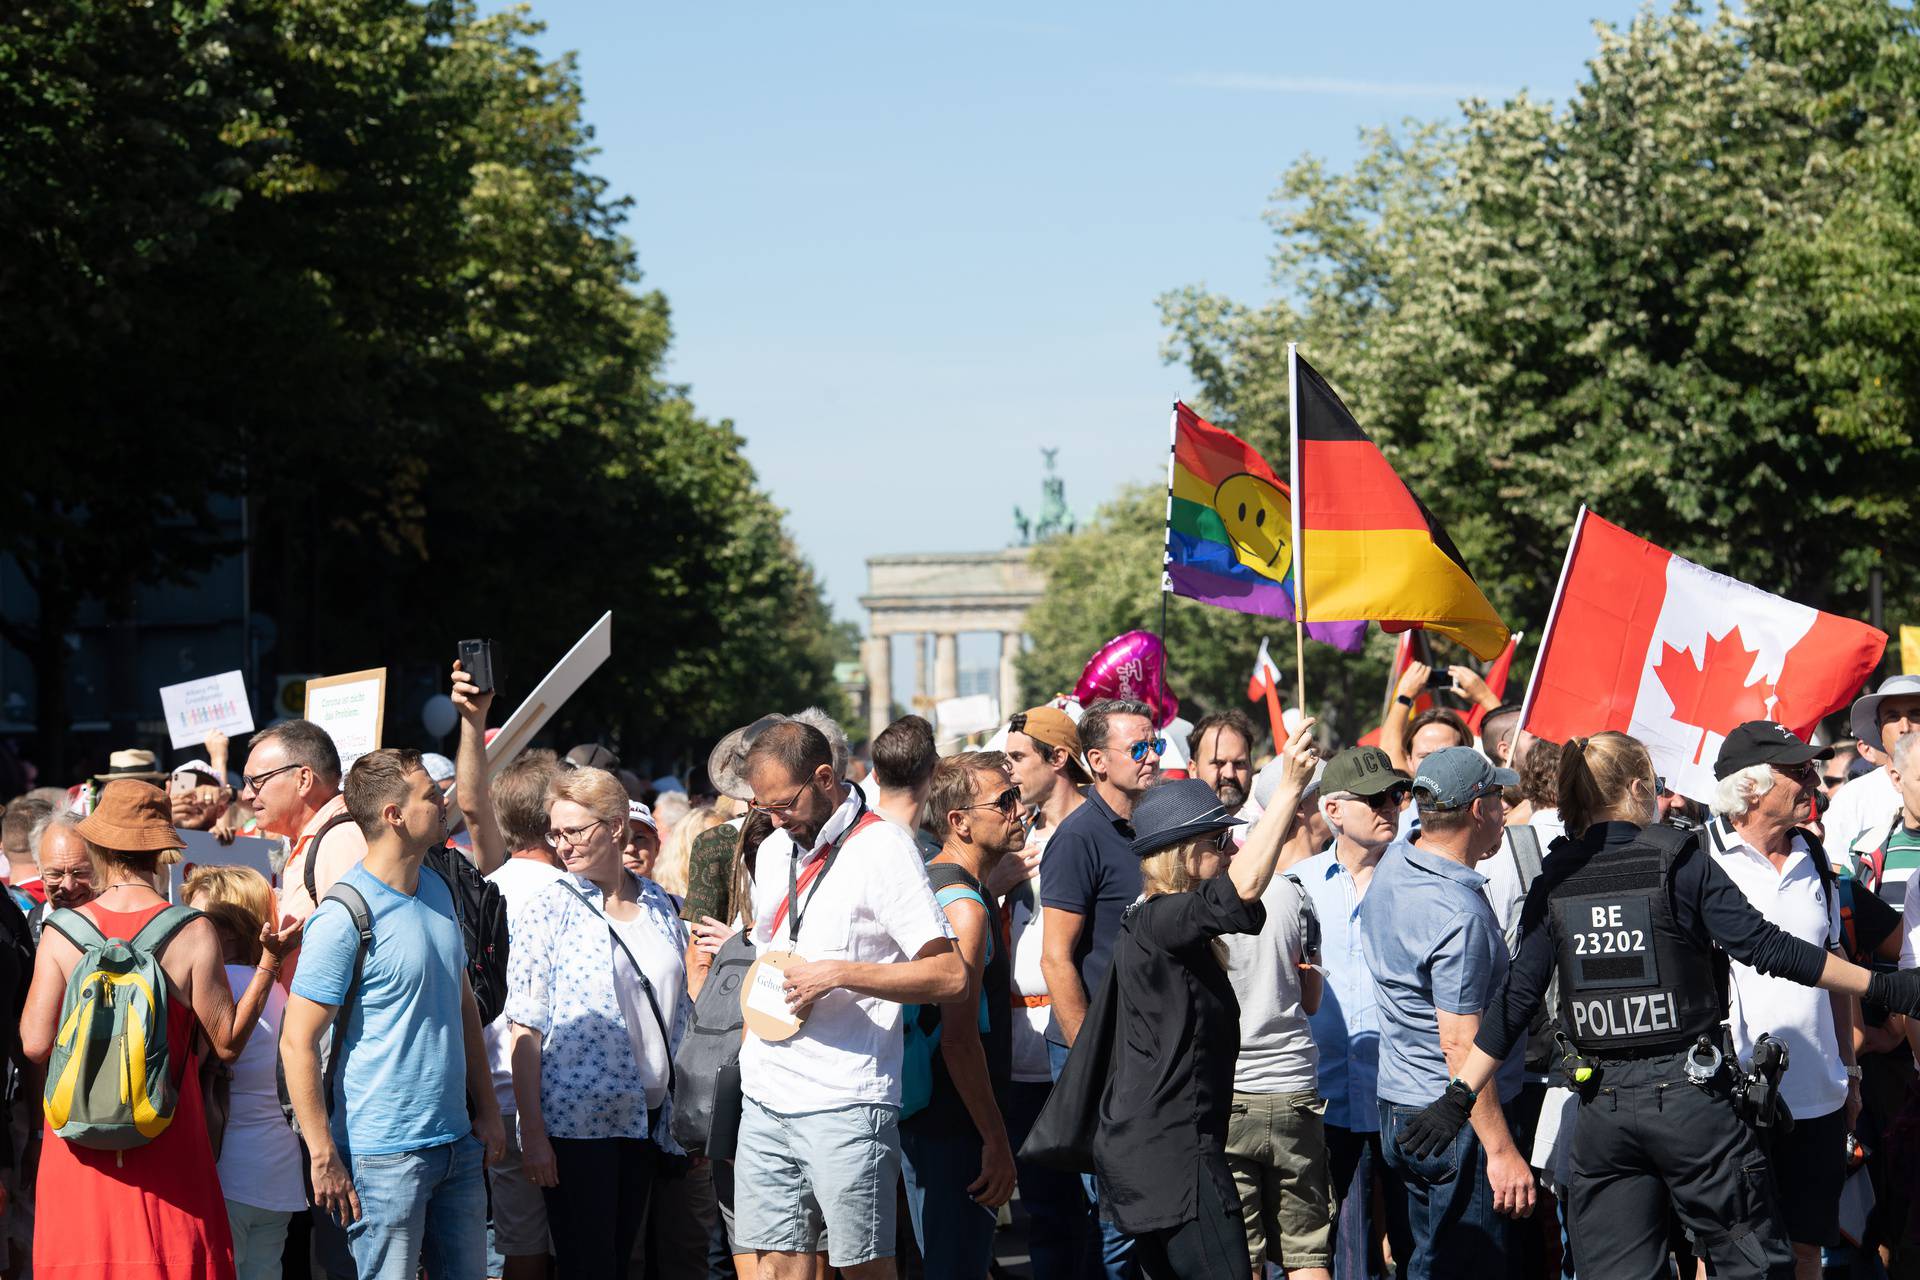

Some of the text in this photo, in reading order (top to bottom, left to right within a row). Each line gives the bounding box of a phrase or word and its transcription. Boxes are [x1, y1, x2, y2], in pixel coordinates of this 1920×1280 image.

[1591, 905, 1623, 928] BE
[1573, 930, 1646, 955] 23202
[1572, 992, 1677, 1037] POLIZEI
